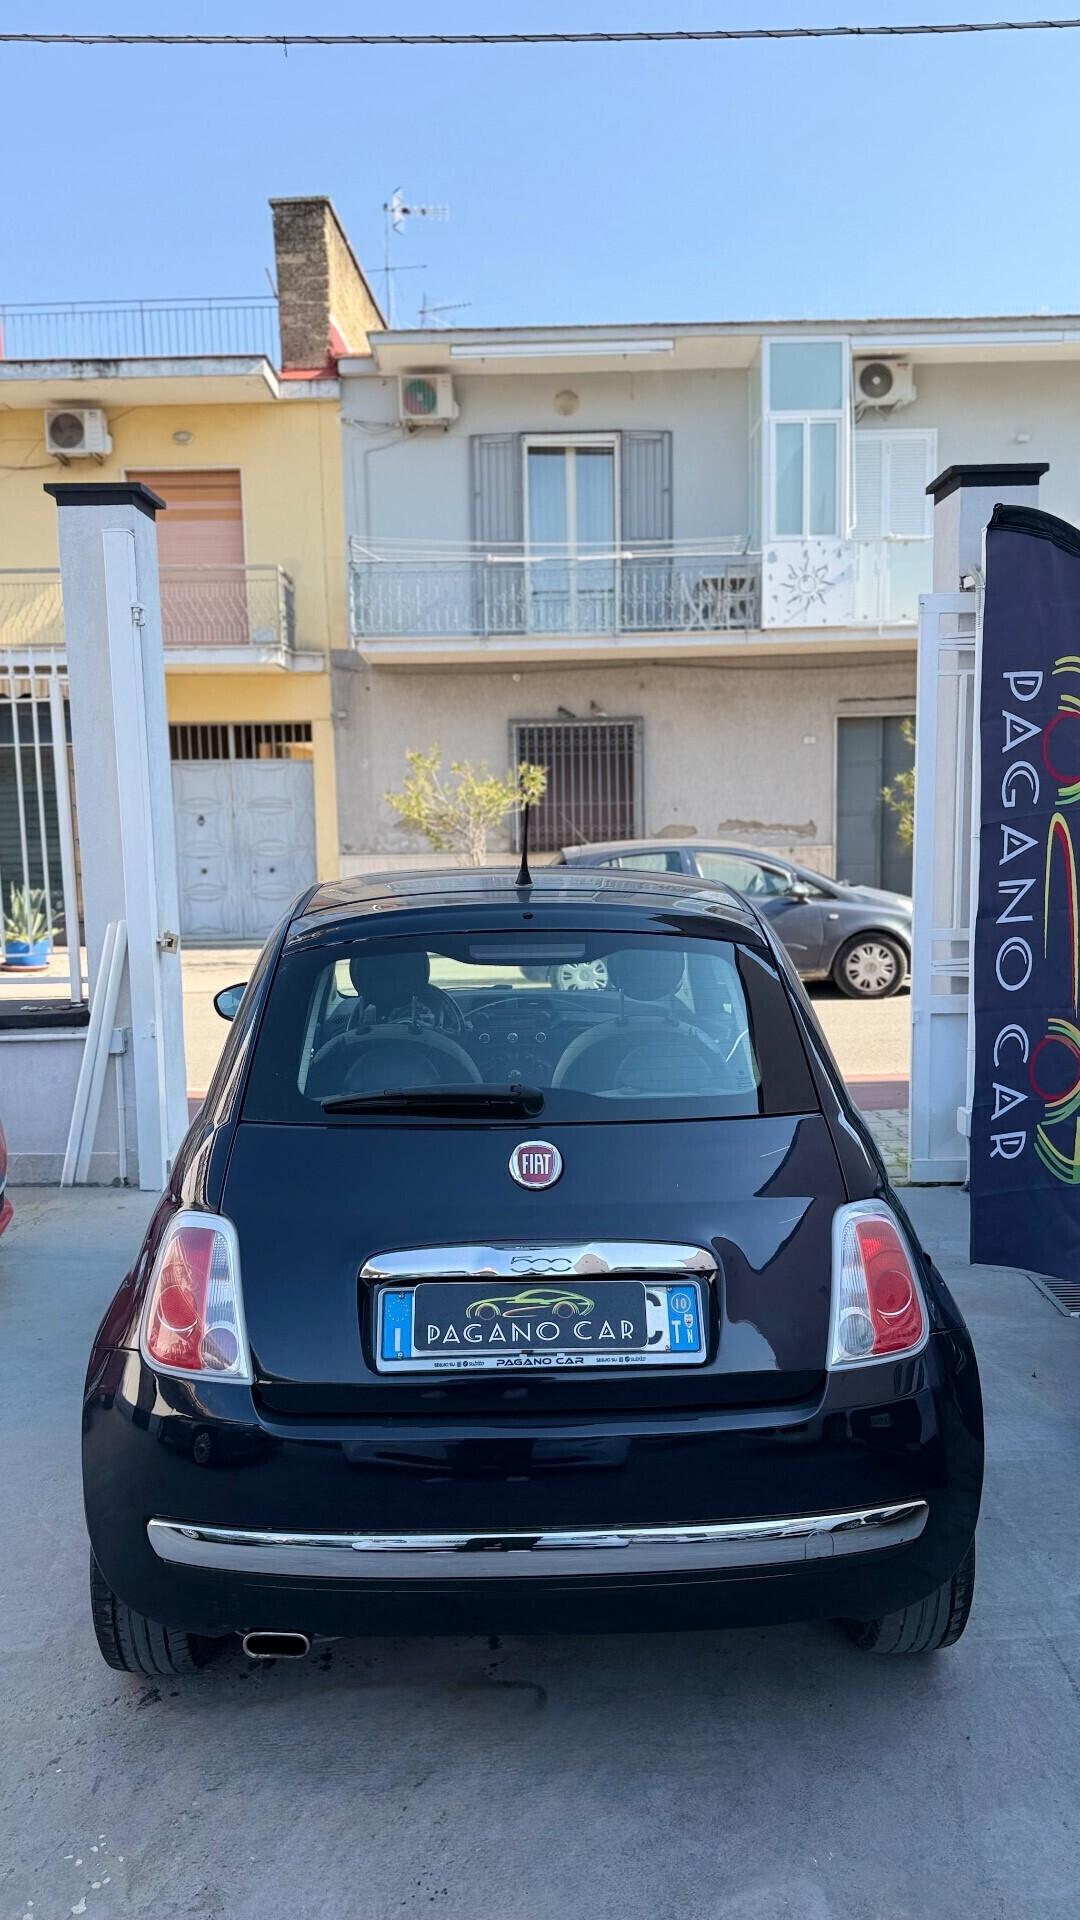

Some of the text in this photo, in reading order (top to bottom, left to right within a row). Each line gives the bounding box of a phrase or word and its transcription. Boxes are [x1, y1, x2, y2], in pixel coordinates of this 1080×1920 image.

[990, 670, 1044, 1160] PAGANO CAR
[522, 1153, 552, 1175] FIAT
[510, 1255, 572, 1273] 500
[674, 1297, 687, 1310] 10
[427, 1319, 635, 1345] PAGANO CAR
[496, 1357, 552, 1367] PAGANO
[555, 1356, 585, 1366] CAR
